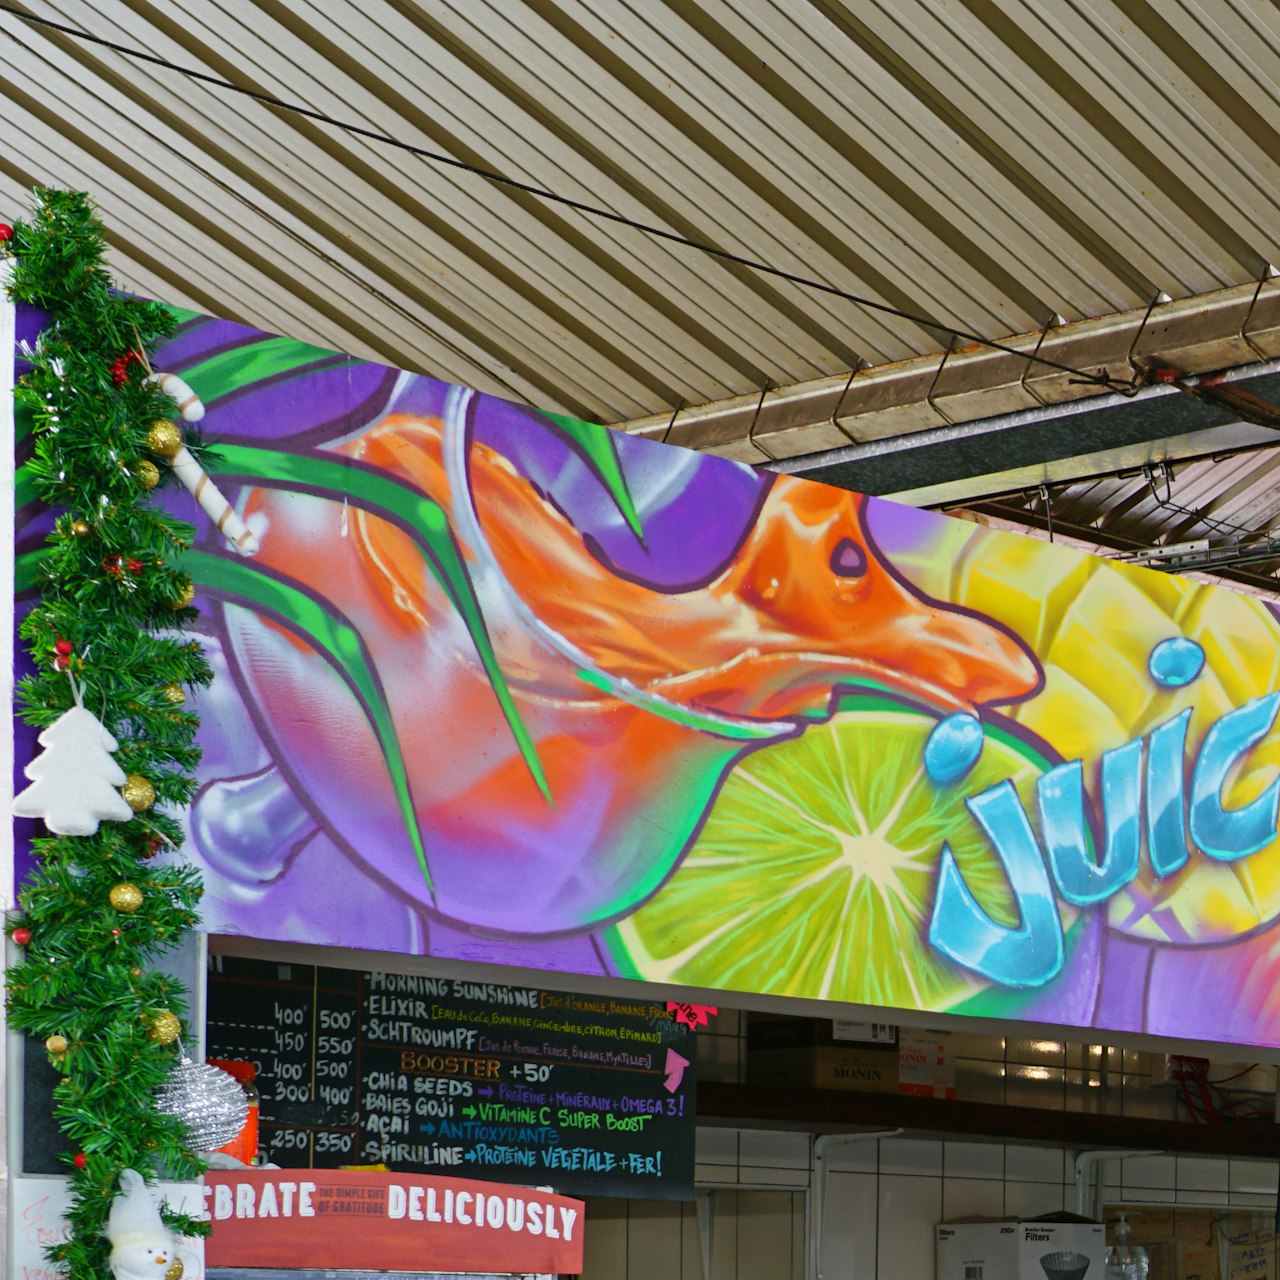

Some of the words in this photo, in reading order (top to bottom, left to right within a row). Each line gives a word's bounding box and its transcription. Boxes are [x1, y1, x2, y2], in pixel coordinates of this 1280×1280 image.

[401, 1051, 501, 1079] BOOSTER
[414, 1077, 474, 1097] SEEDS
[558, 1109, 600, 1129] SUPER
[388, 1184, 578, 1241] DELICIOUSLY
[1025, 1232, 1050, 1242] Filters
